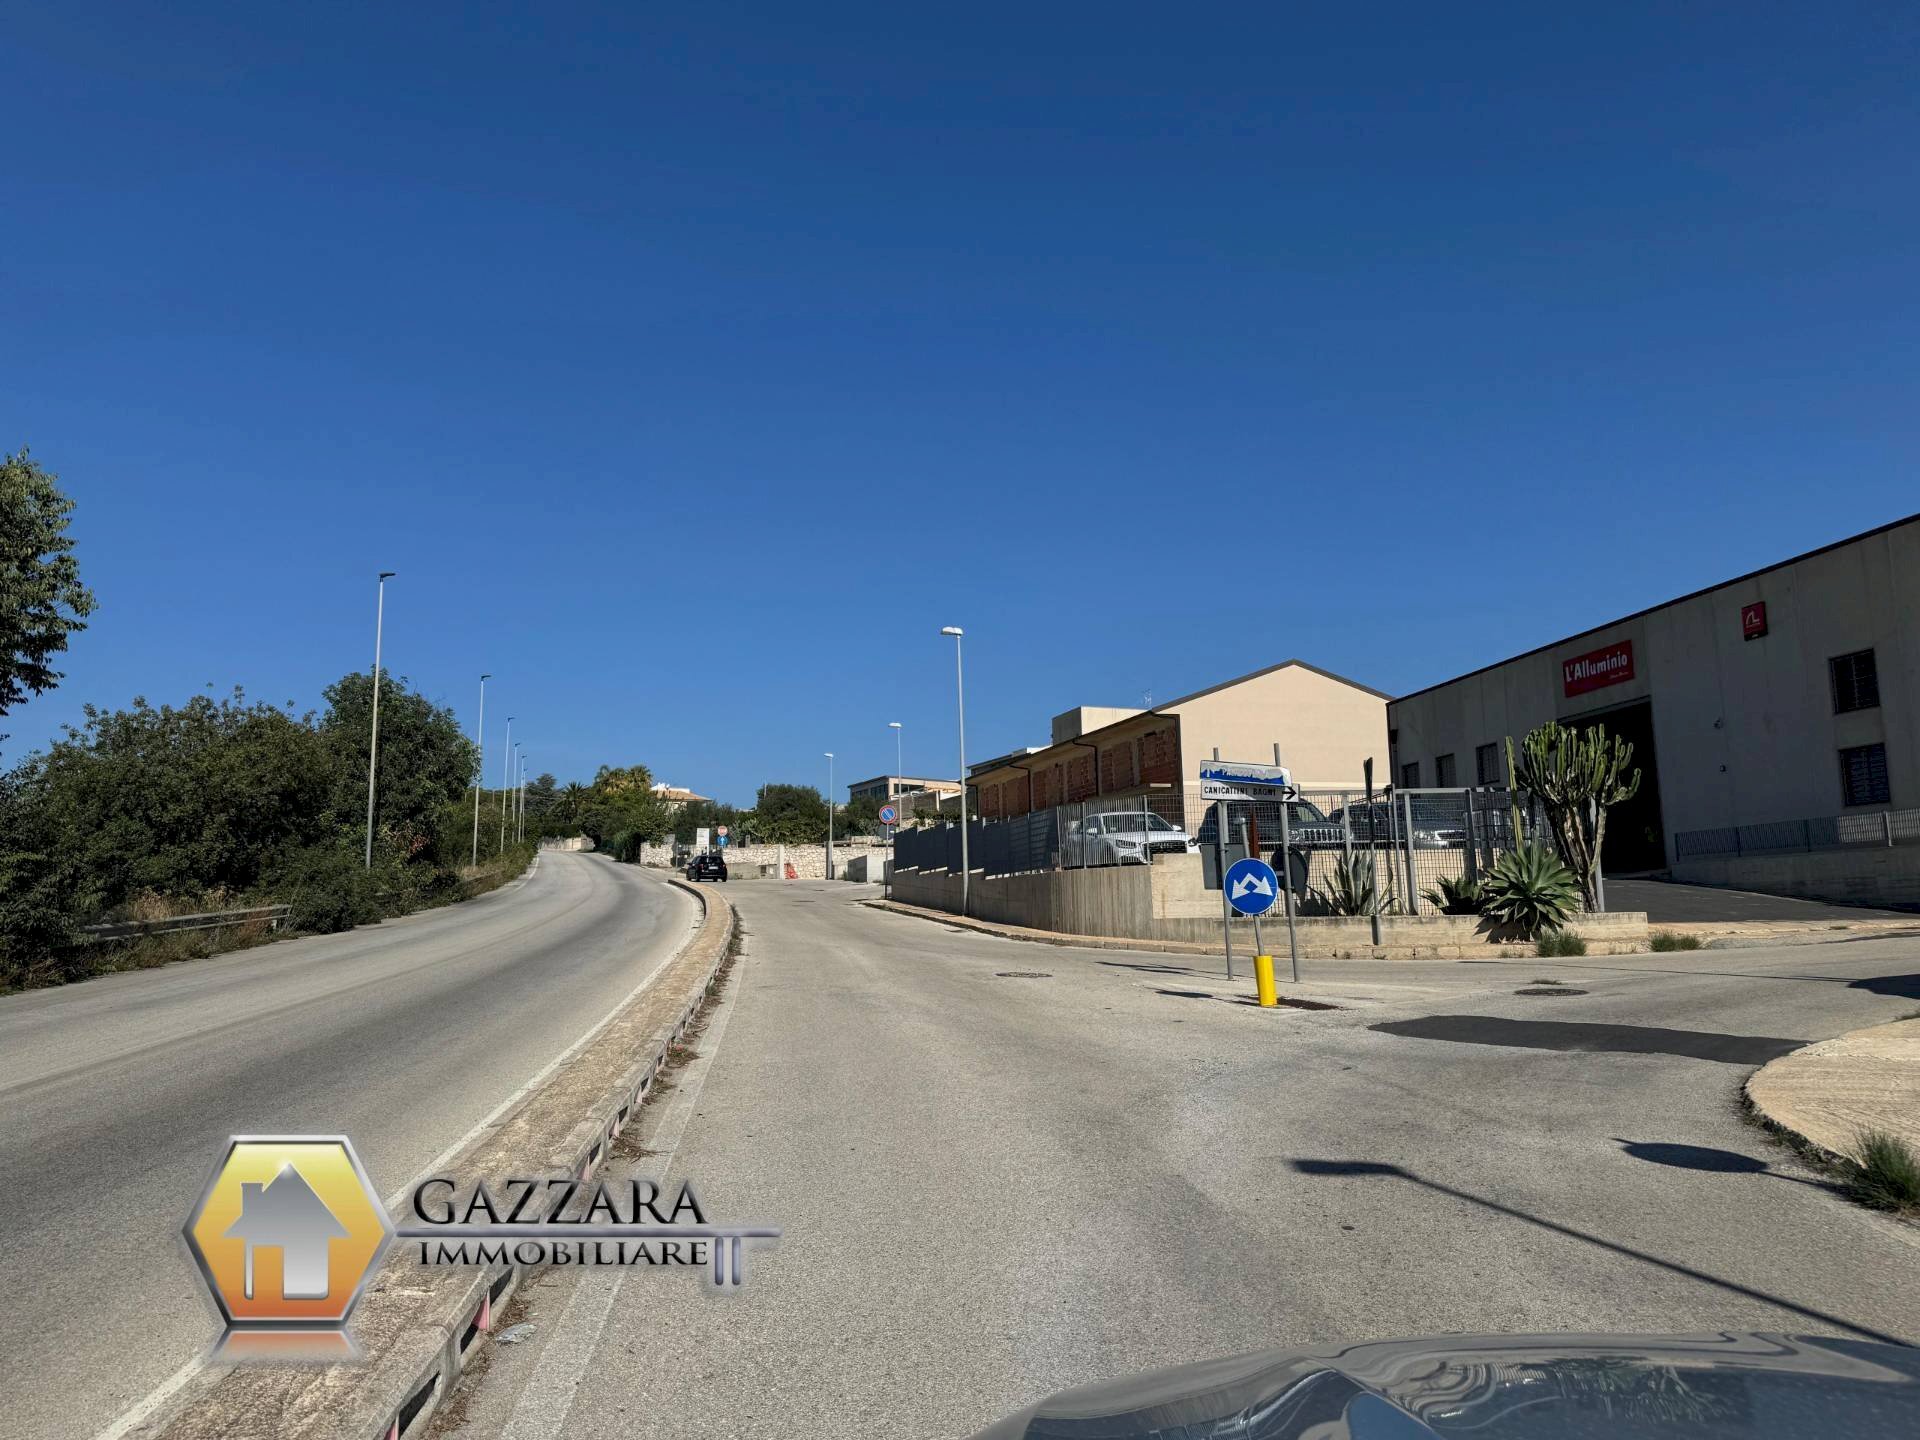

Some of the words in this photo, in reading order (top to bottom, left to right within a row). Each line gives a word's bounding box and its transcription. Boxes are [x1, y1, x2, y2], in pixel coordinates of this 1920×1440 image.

[1565, 651, 1628, 682] L'Alluminio
[1204, 786, 1248, 795] CANICATTINI
[1253, 787, 1276, 796] BAGNI
